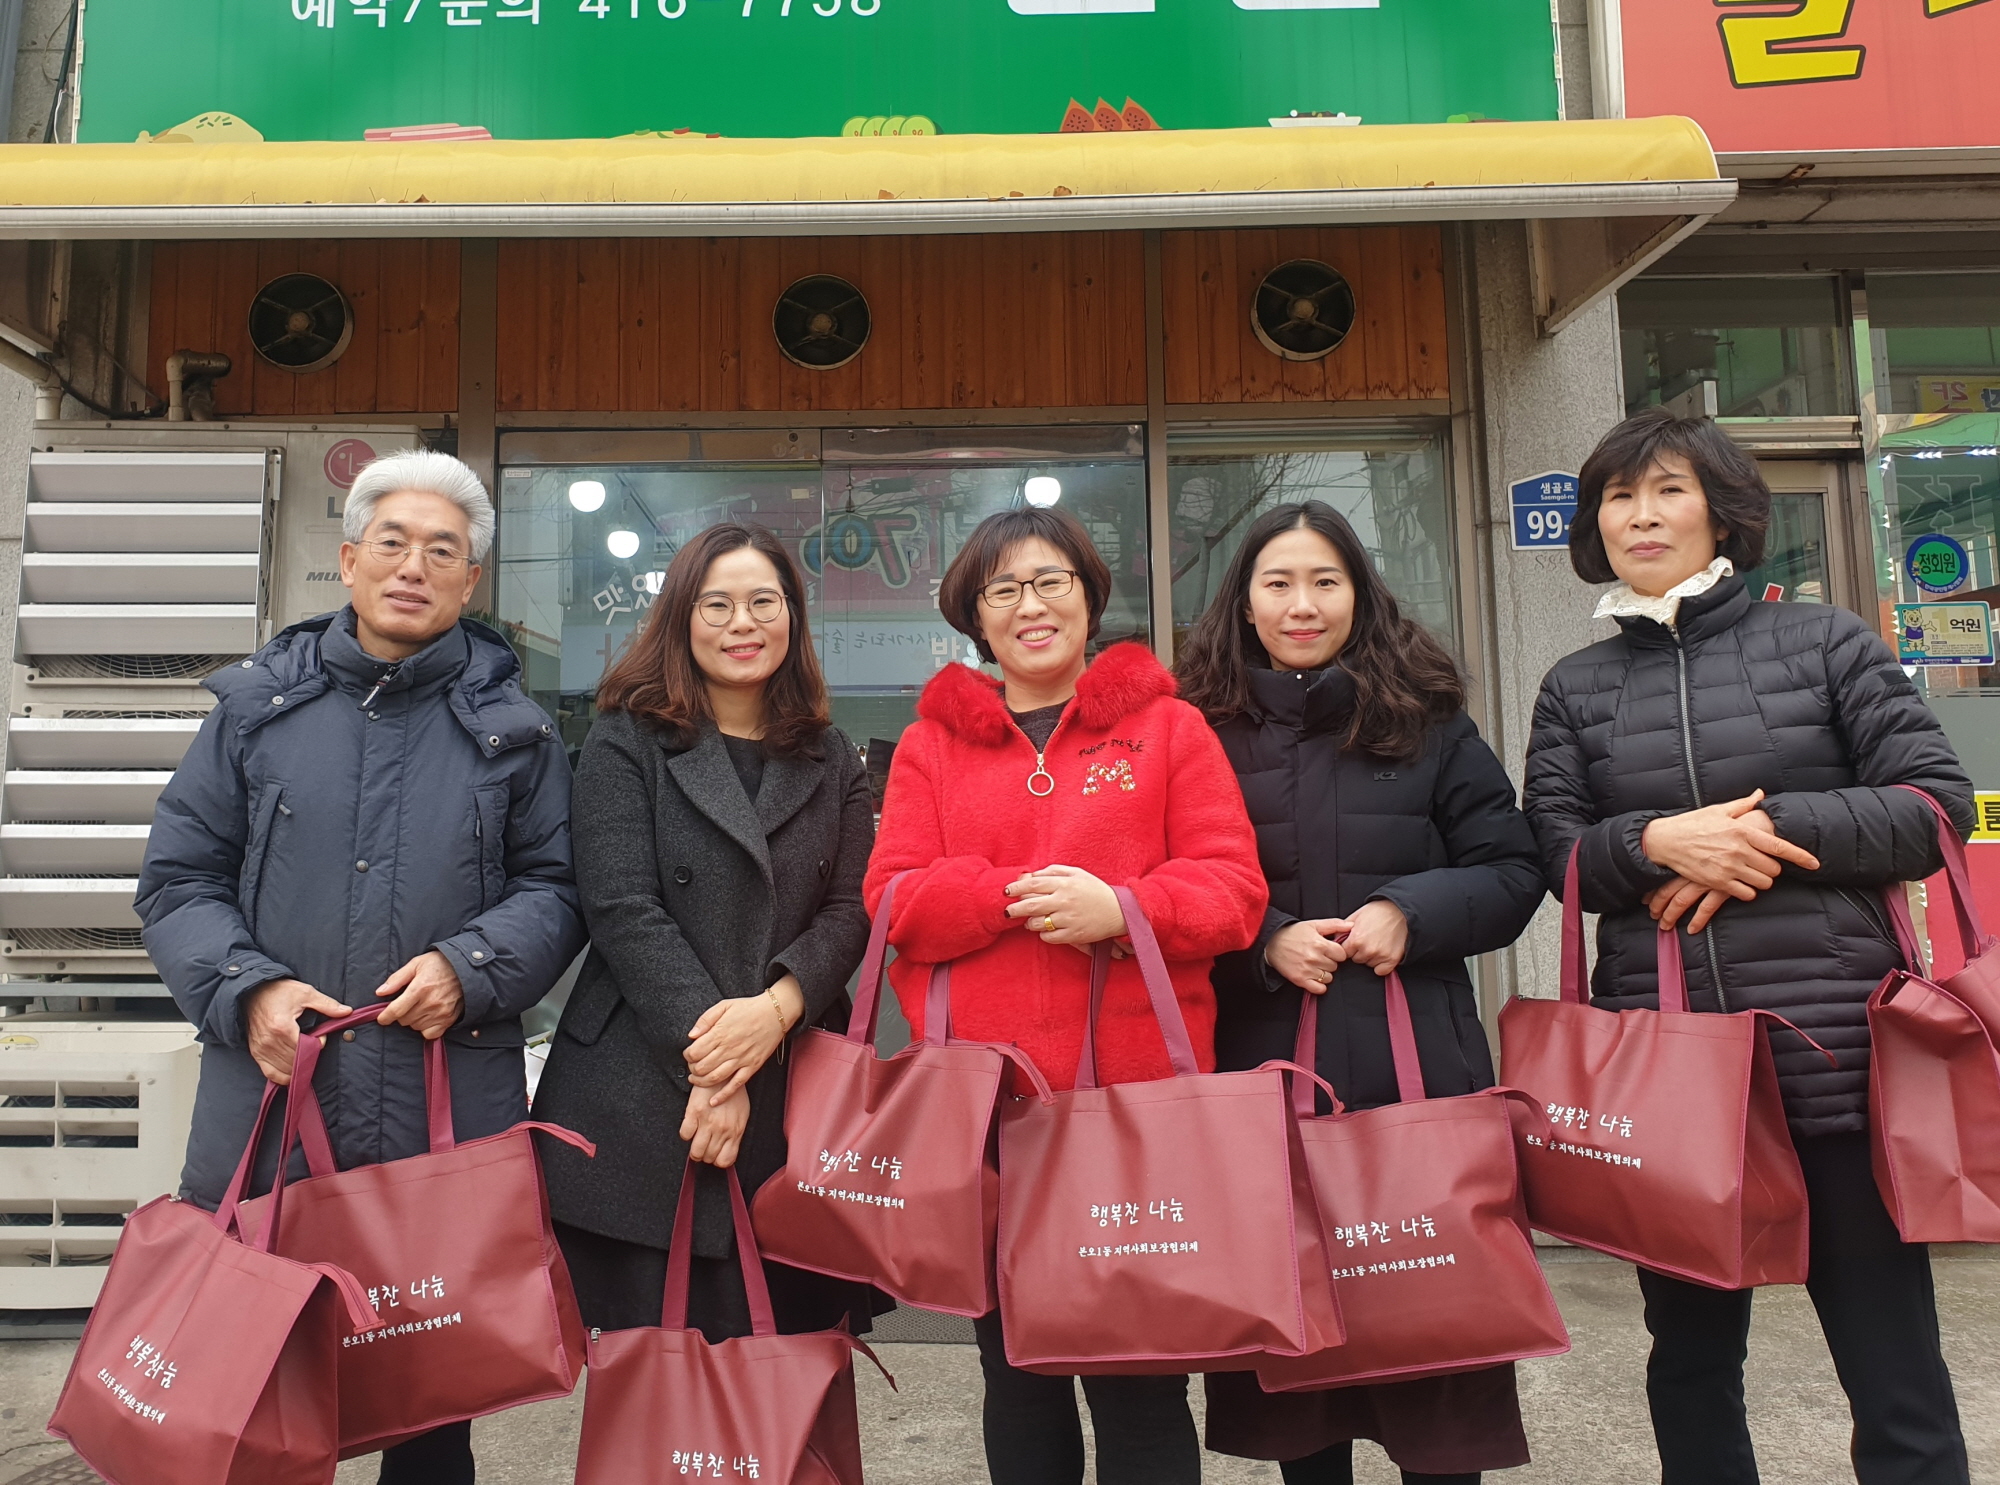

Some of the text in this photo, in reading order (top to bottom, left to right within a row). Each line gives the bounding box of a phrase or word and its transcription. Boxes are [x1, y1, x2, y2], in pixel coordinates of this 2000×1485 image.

[1540, 481, 1574, 494] 샘골로
[1918, 552, 1956, 574] 정회원
[1373, 771, 1398, 781] K2
[1546, 1102, 1633, 1138] 행복찬 나눔
[871, 1156, 903, 1179] 나눔
[797, 1180, 826, 1197] 본오1동
[1090, 1197, 1185, 1228] 행복찬 나눔
[1334, 1214, 1437, 1248] 행복찬 나눔
[1078, 1240, 1198, 1257] 본오1동 지역사회보장협의체
[1368, 1253, 1456, 1275] 지역사회보장협의체
[367, 1274, 445, 1312] 복찬 나눔
[342, 1312, 462, 1348] 본오1동 지역사회보장협의체
[671, 1449, 760, 1479] 행복찬 나눔
